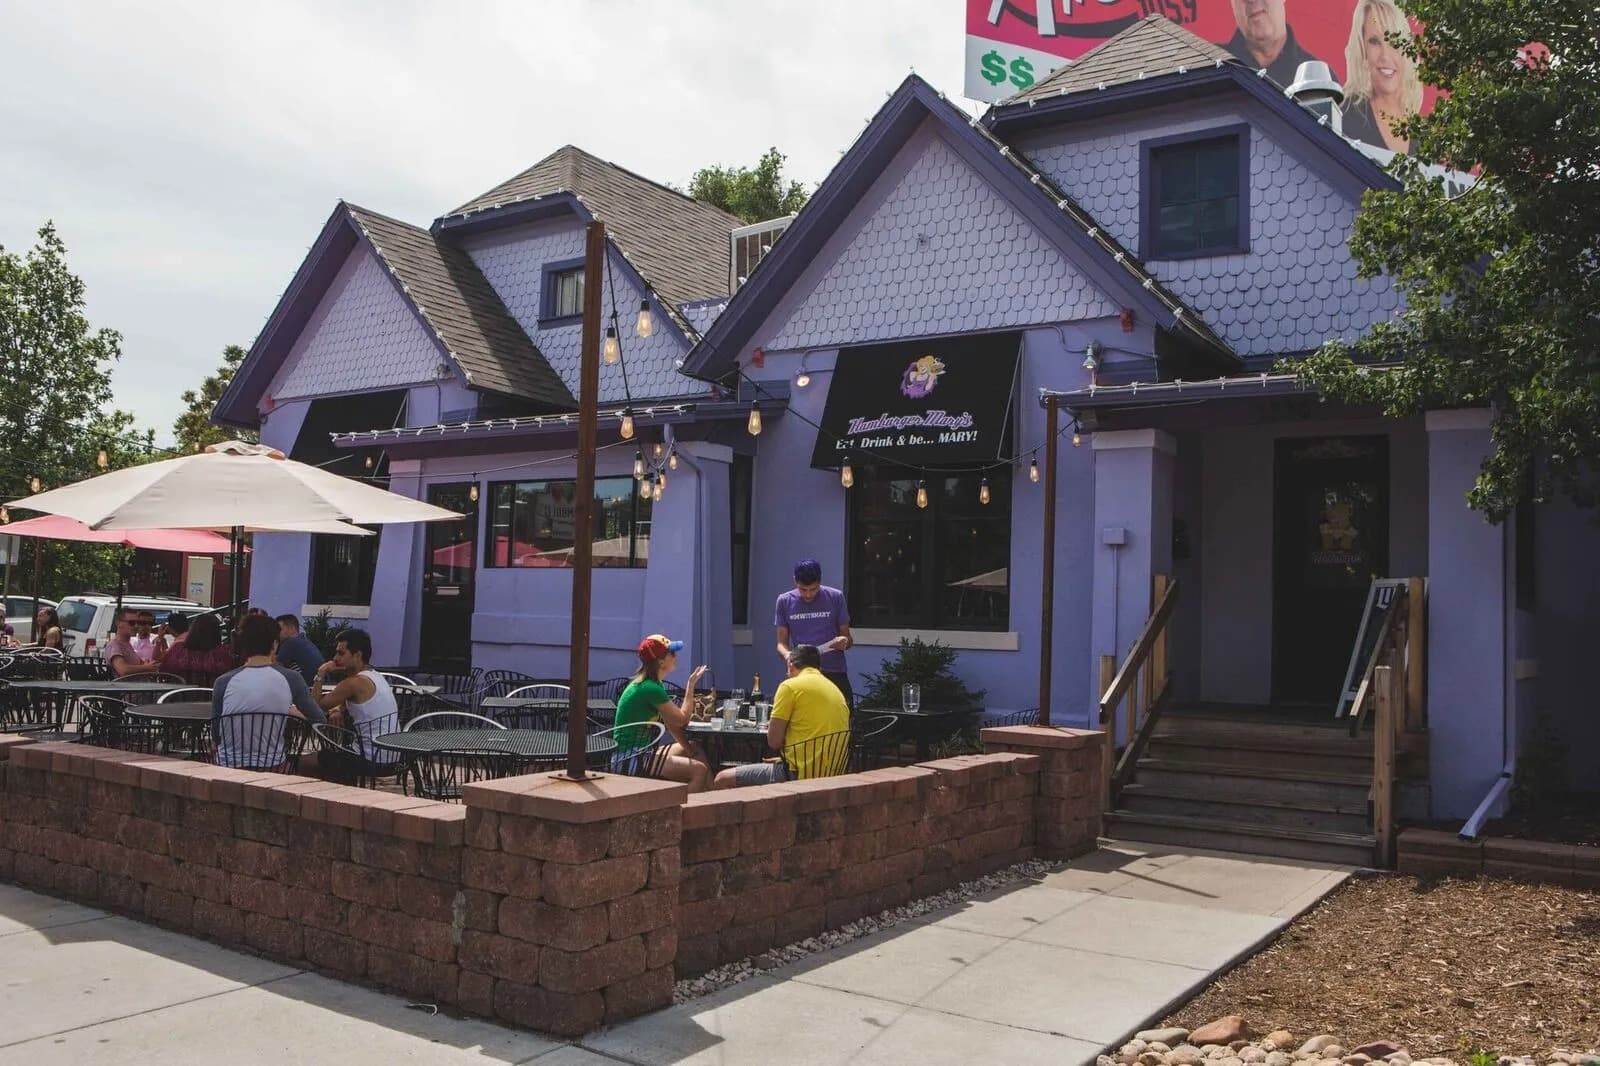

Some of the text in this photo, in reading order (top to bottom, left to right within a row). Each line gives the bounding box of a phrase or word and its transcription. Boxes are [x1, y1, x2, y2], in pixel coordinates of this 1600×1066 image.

[847, 410, 973, 434] Hamburger Mary's
[860, 434, 893, 448] Drink
[896, 435, 906, 446] &
[909, 434, 934, 445] be...
[938, 431, 978, 443] MARY!
